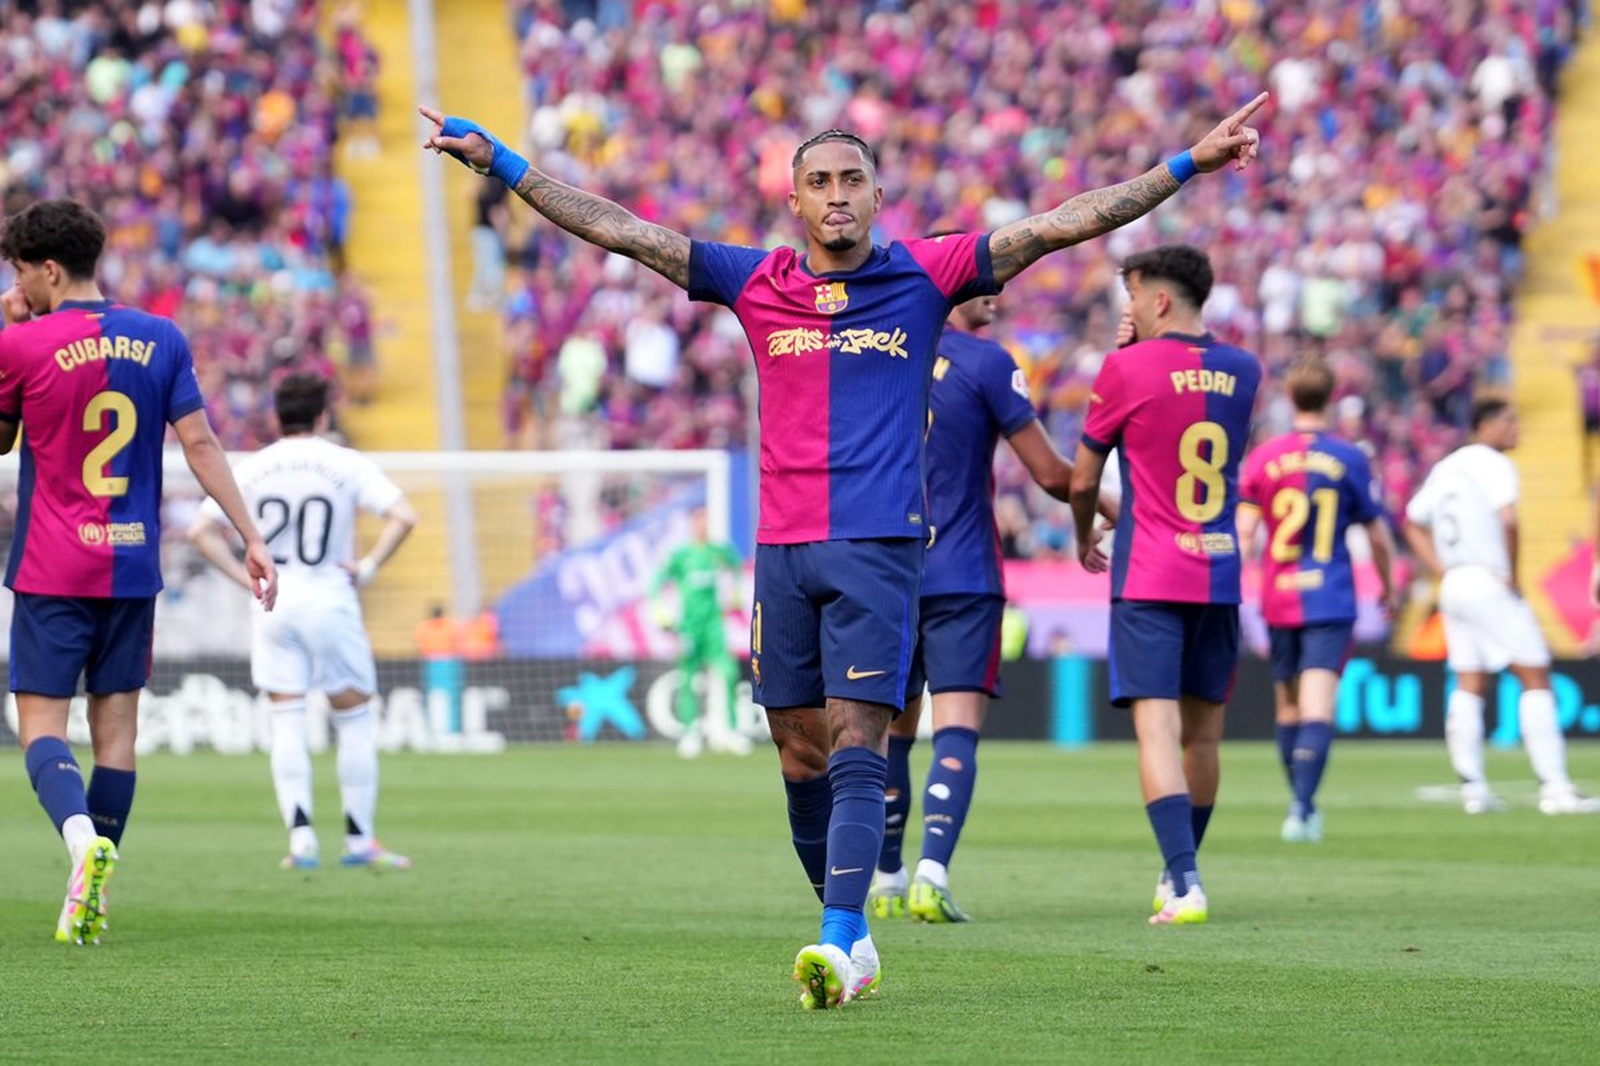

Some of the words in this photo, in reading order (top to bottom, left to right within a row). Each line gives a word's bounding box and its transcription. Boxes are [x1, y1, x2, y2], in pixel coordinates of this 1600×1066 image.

[54, 336, 156, 372] CUBARSÍ
[1171, 370, 1236, 397] PEDRI
[82, 391, 137, 497] 2
[1177, 422, 1228, 523] 8
[258, 496, 333, 566] 20
[1269, 485, 1338, 564] 21
